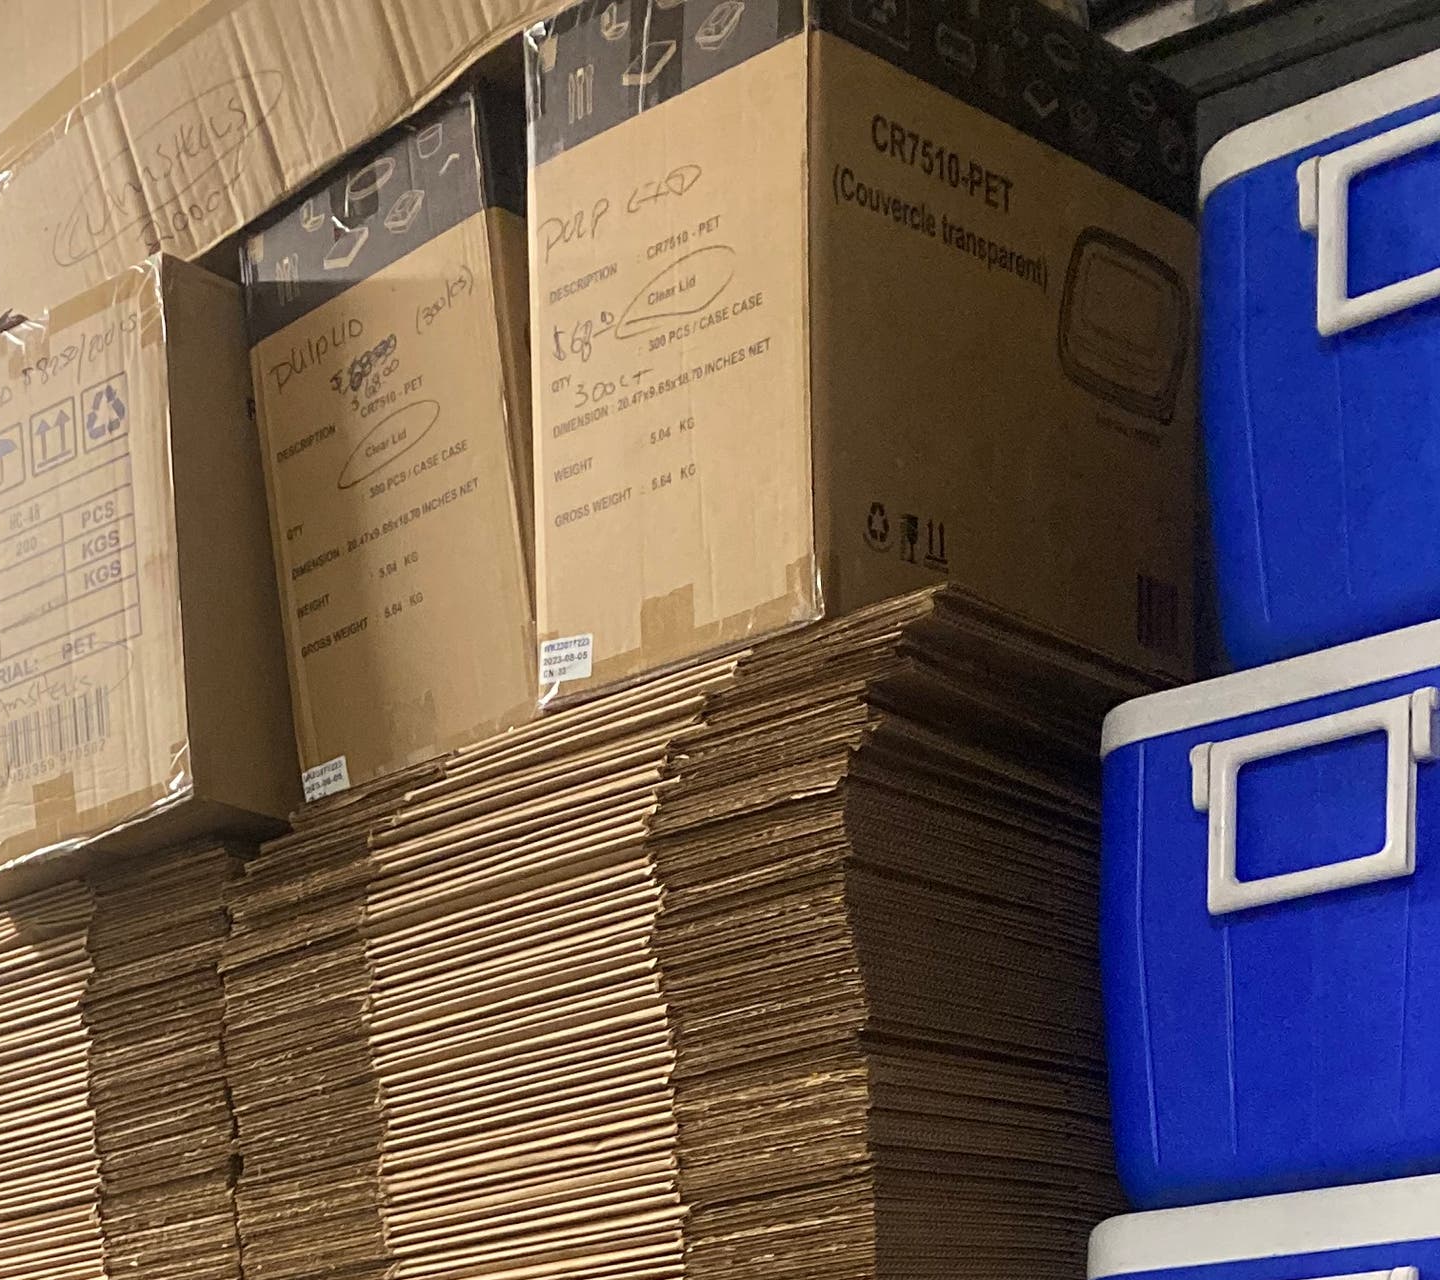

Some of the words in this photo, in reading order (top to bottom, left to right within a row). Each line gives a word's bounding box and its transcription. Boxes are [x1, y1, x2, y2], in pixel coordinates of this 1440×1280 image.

[870, 112, 1015, 214] CR7510-PET
[698, 214, 721, 238] PET
[832, 163, 937, 238] (Couvercle
[940, 212, 1050, 295] transparent)
[549, 263, 618, 305] DESCRIPTION
[647, 286, 676, 306] Clear
[678, 274, 697, 293] Lid
[668, 321, 691, 343] PCS
[698, 305, 730, 331] CASE
[731, 292, 764, 316] CASE
[551, 374, 573, 394] QTY
[552, 406, 610, 439] DIMENSION
[704, 350, 747, 377] INCHES
[747, 336, 772, 357] NET
[275, 423, 337, 464] DESCRIPTION
[412, 456, 439, 477] CASE
[441, 439, 468, 460] CASE
[553, 456, 594, 483] WEIGHT
[678, 416, 697, 433] KG
[80, 500, 115, 529] PCS
[422, 486, 458, 516] INCHES
[459, 476, 480, 497] NET
[554, 503, 591, 528] GROSS
[592, 486, 633, 513] WEIGHT
[679, 463, 698, 481] KG
[81, 529, 121, 561] KGS
[83, 559, 122, 591] KGS
[297, 593, 330, 621] WEIGHT
[61, 632, 96, 661] PET
[333, 616, 369, 643] WEIGHT
